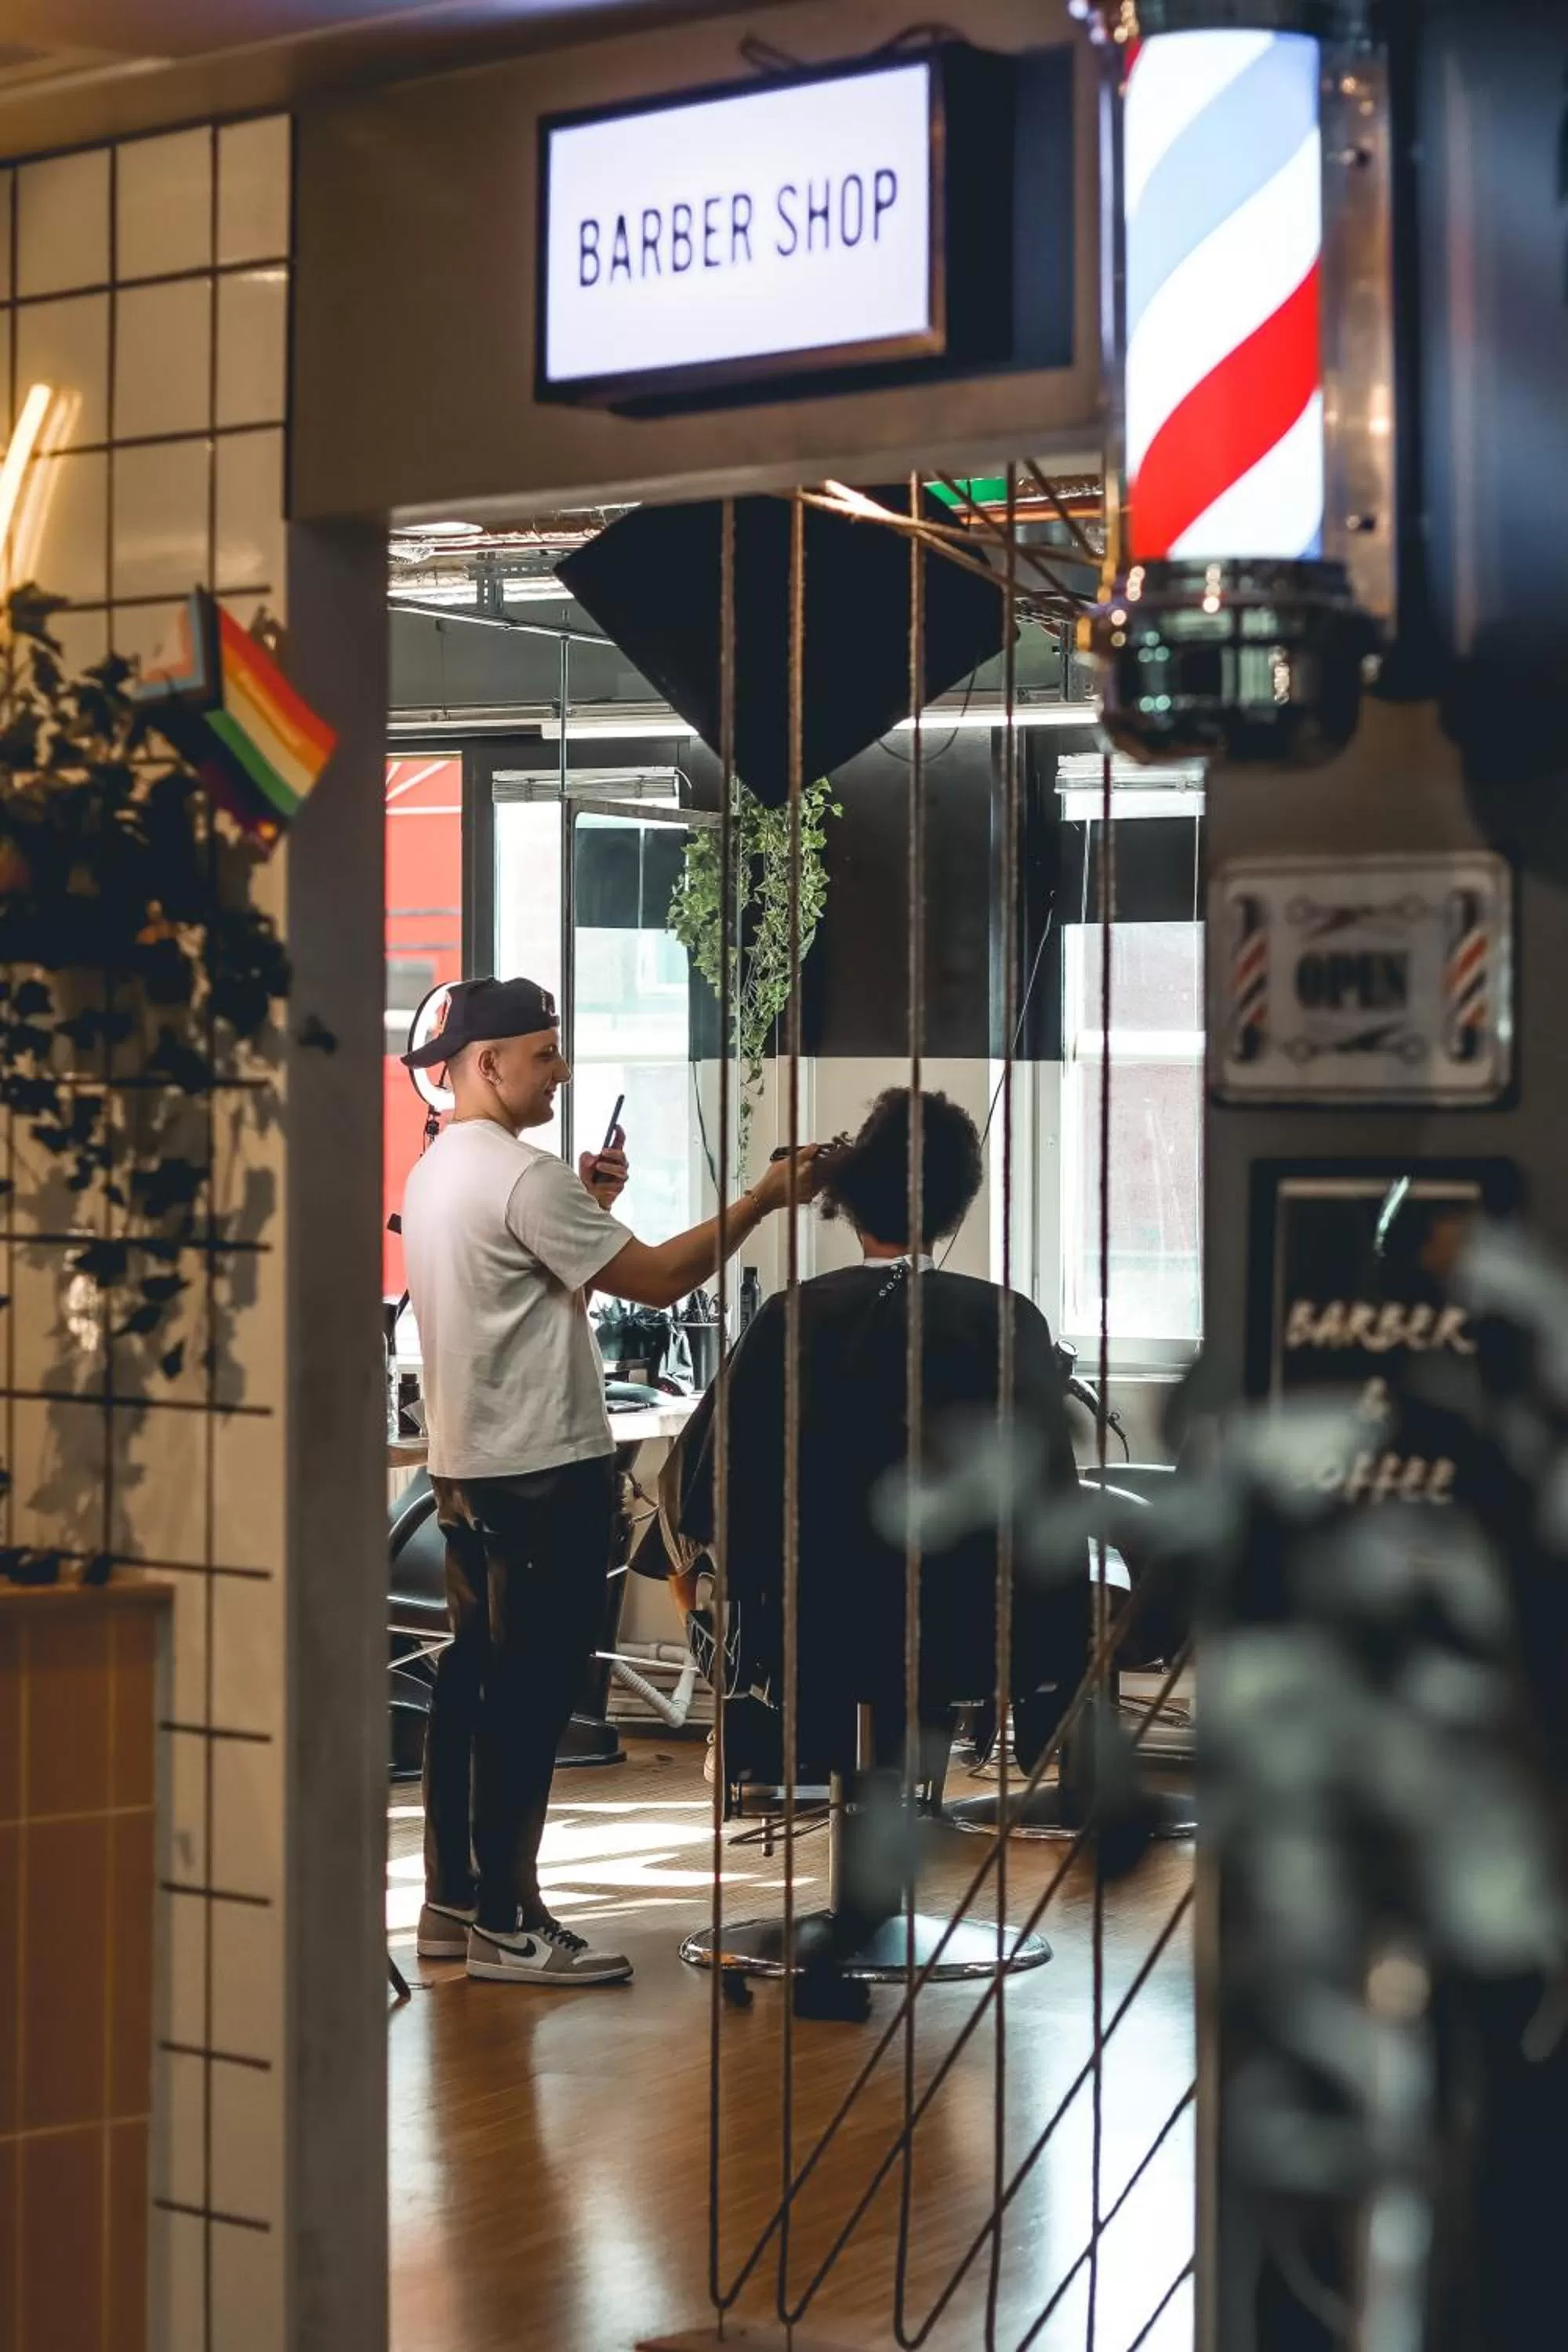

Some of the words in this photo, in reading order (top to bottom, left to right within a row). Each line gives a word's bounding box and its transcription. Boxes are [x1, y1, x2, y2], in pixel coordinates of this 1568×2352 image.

[579, 192, 753, 288] BARBER
[775, 167, 898, 257] SHOP
[1286, 1298, 1477, 1354] BARBER
[1306, 1451, 1457, 1505] OFFEE
